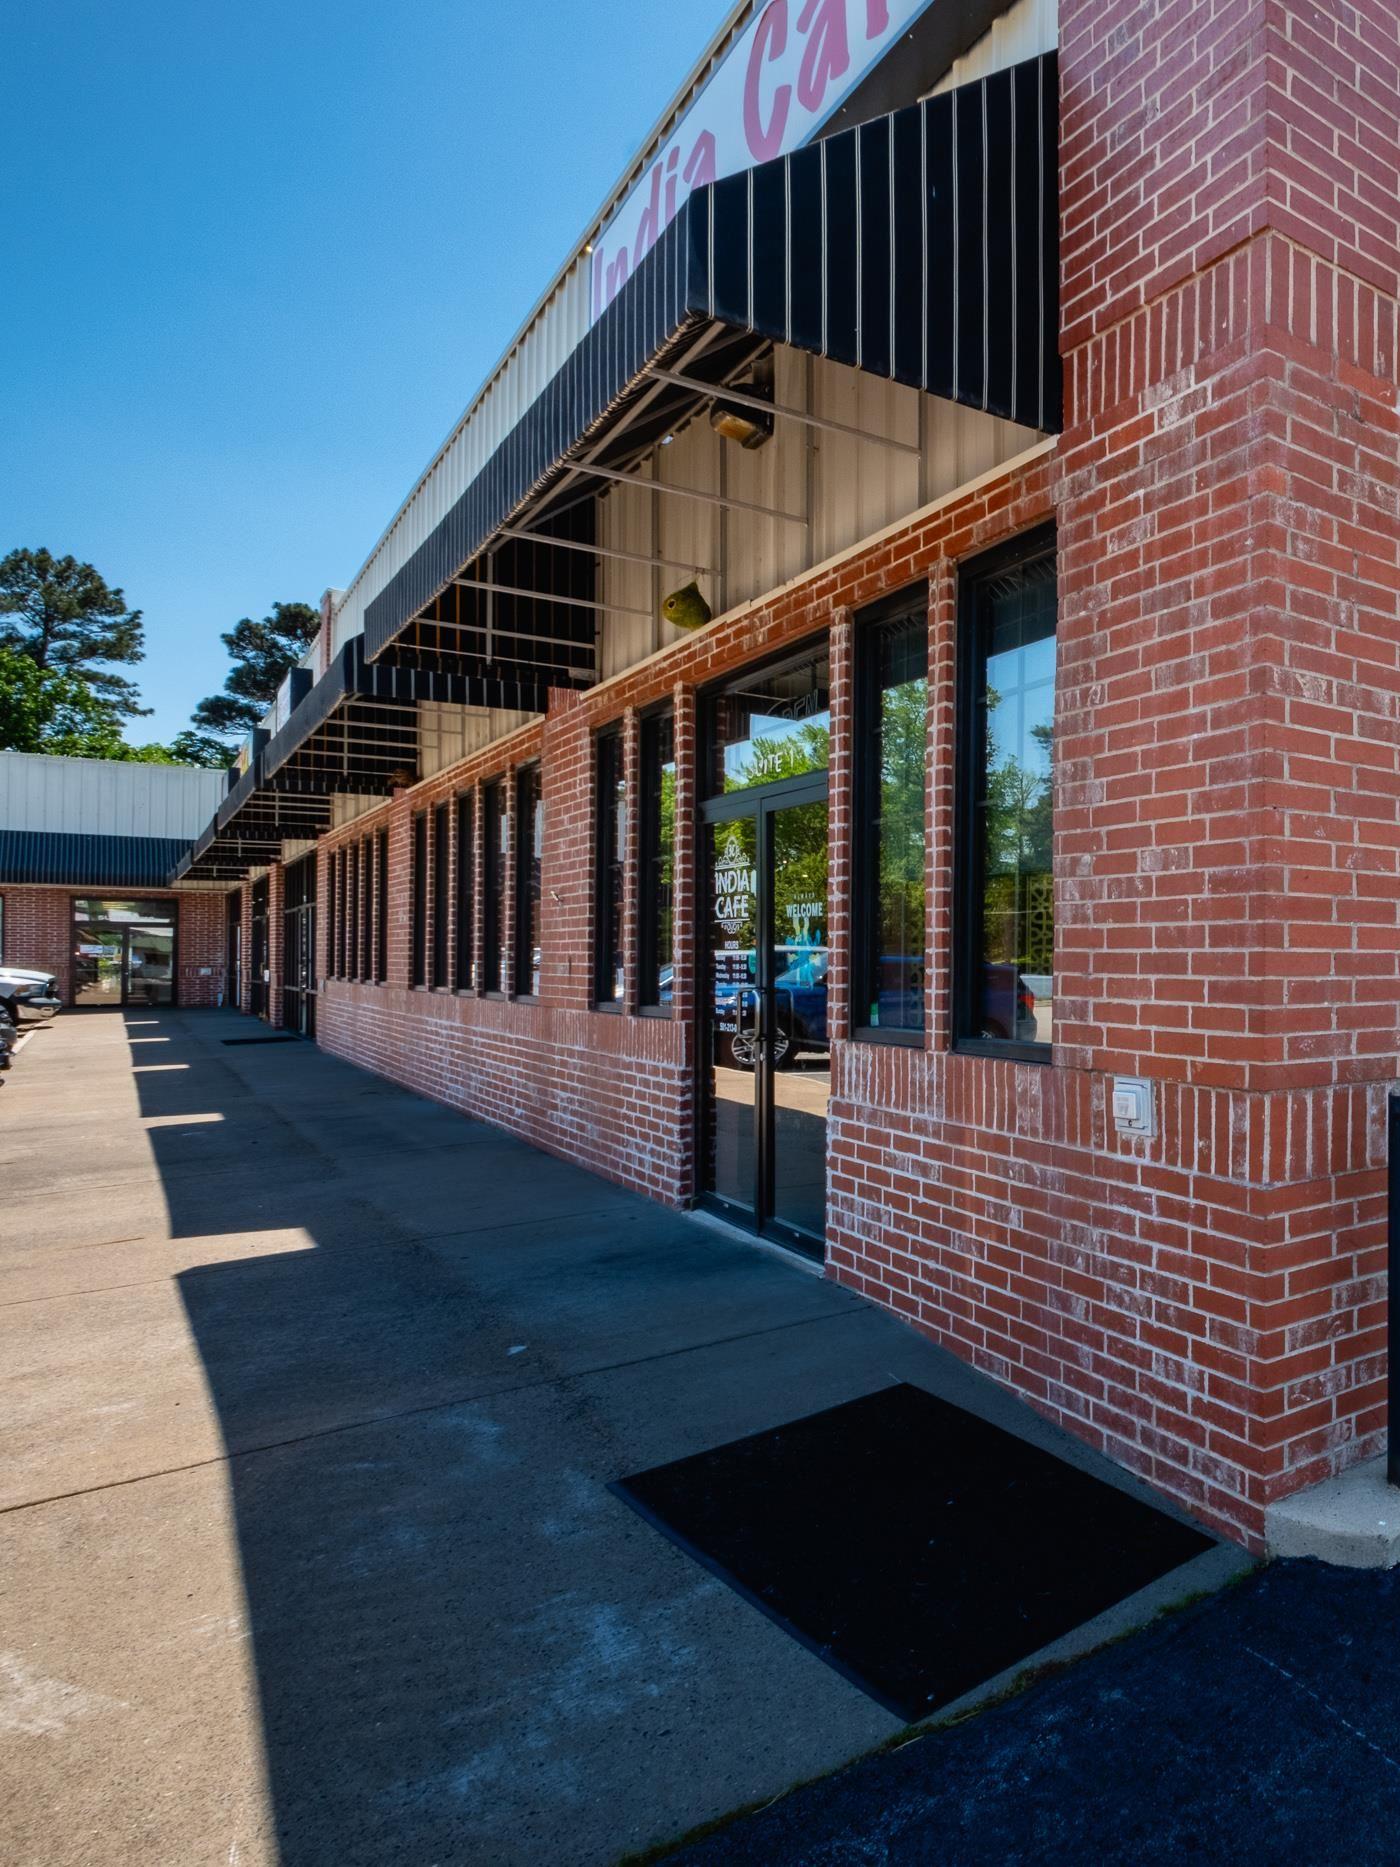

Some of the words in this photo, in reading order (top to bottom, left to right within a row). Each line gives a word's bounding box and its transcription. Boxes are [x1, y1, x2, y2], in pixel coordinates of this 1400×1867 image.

[743, 0, 890, 163] Ca
[714, 869, 750, 895] INDIA
[715, 895, 749, 919] CAFE
[785, 902, 823, 918] WELCOME
